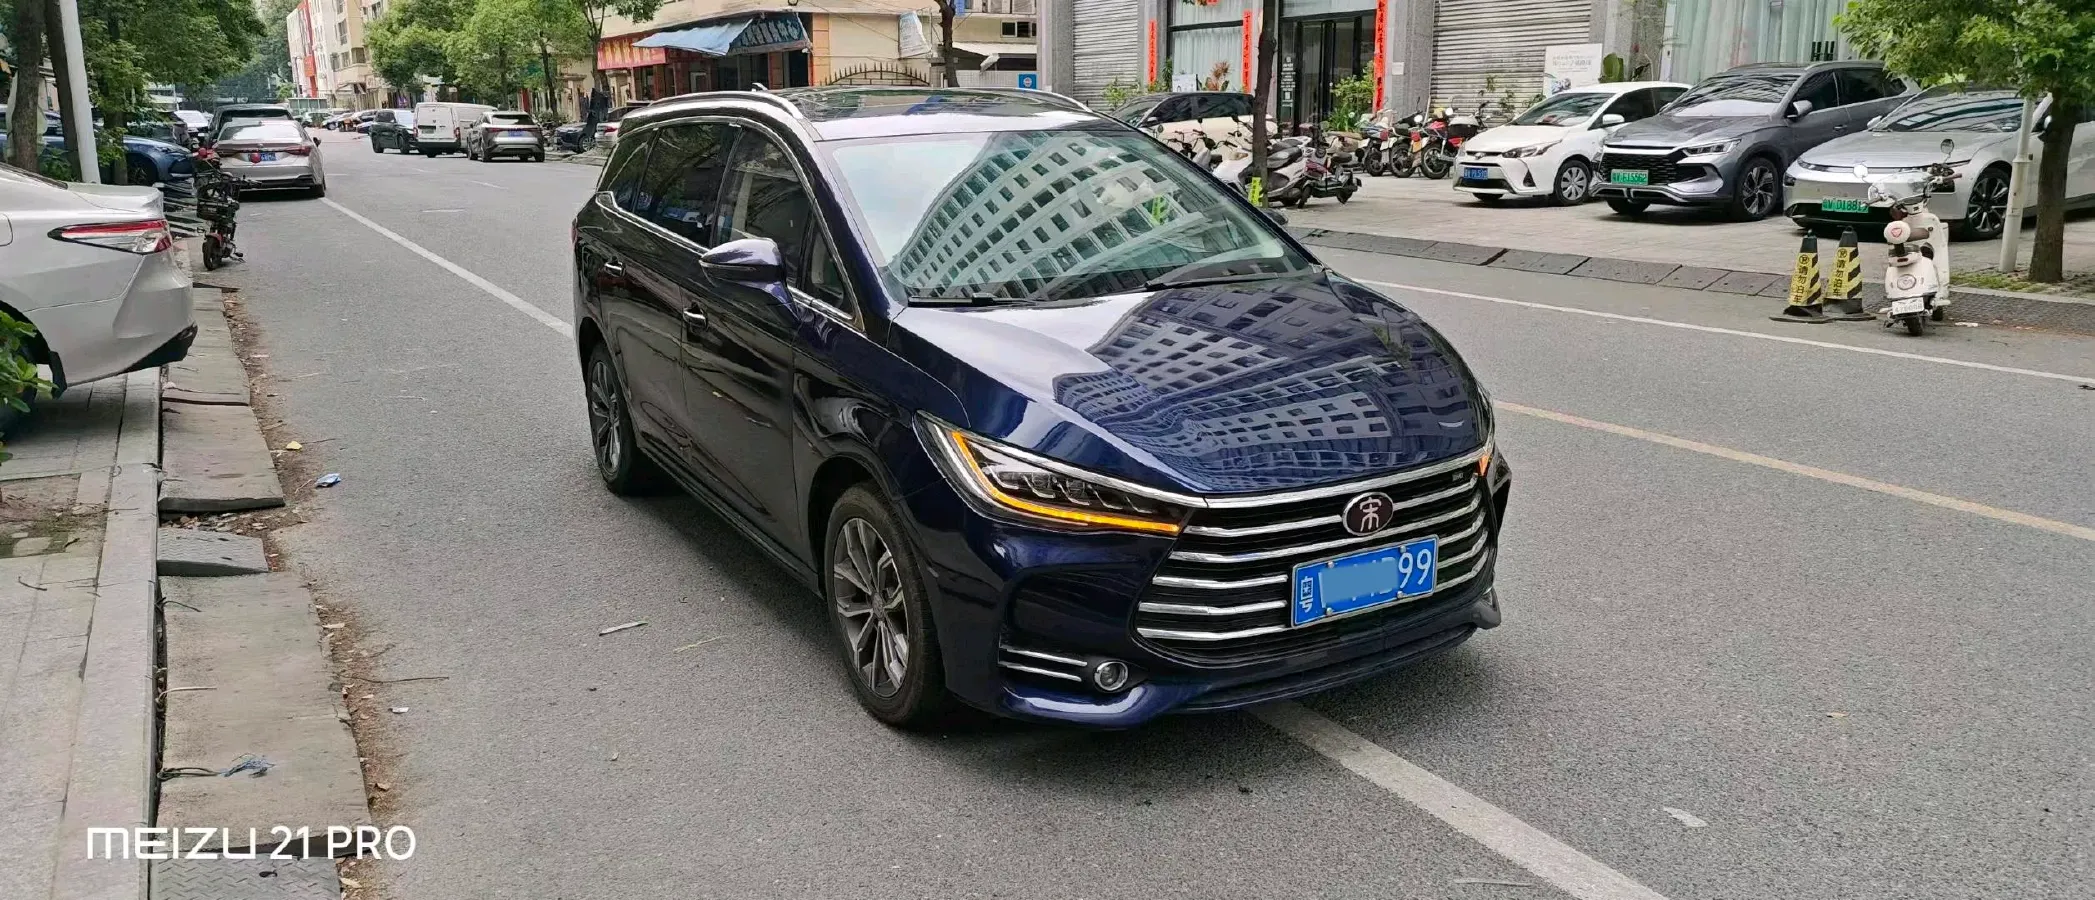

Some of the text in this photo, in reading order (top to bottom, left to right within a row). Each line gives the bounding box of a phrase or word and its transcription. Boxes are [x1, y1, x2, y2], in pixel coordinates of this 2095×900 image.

[1833, 259, 1846, 296] 请勿泊车
[1359, 497, 1382, 532] 宋
